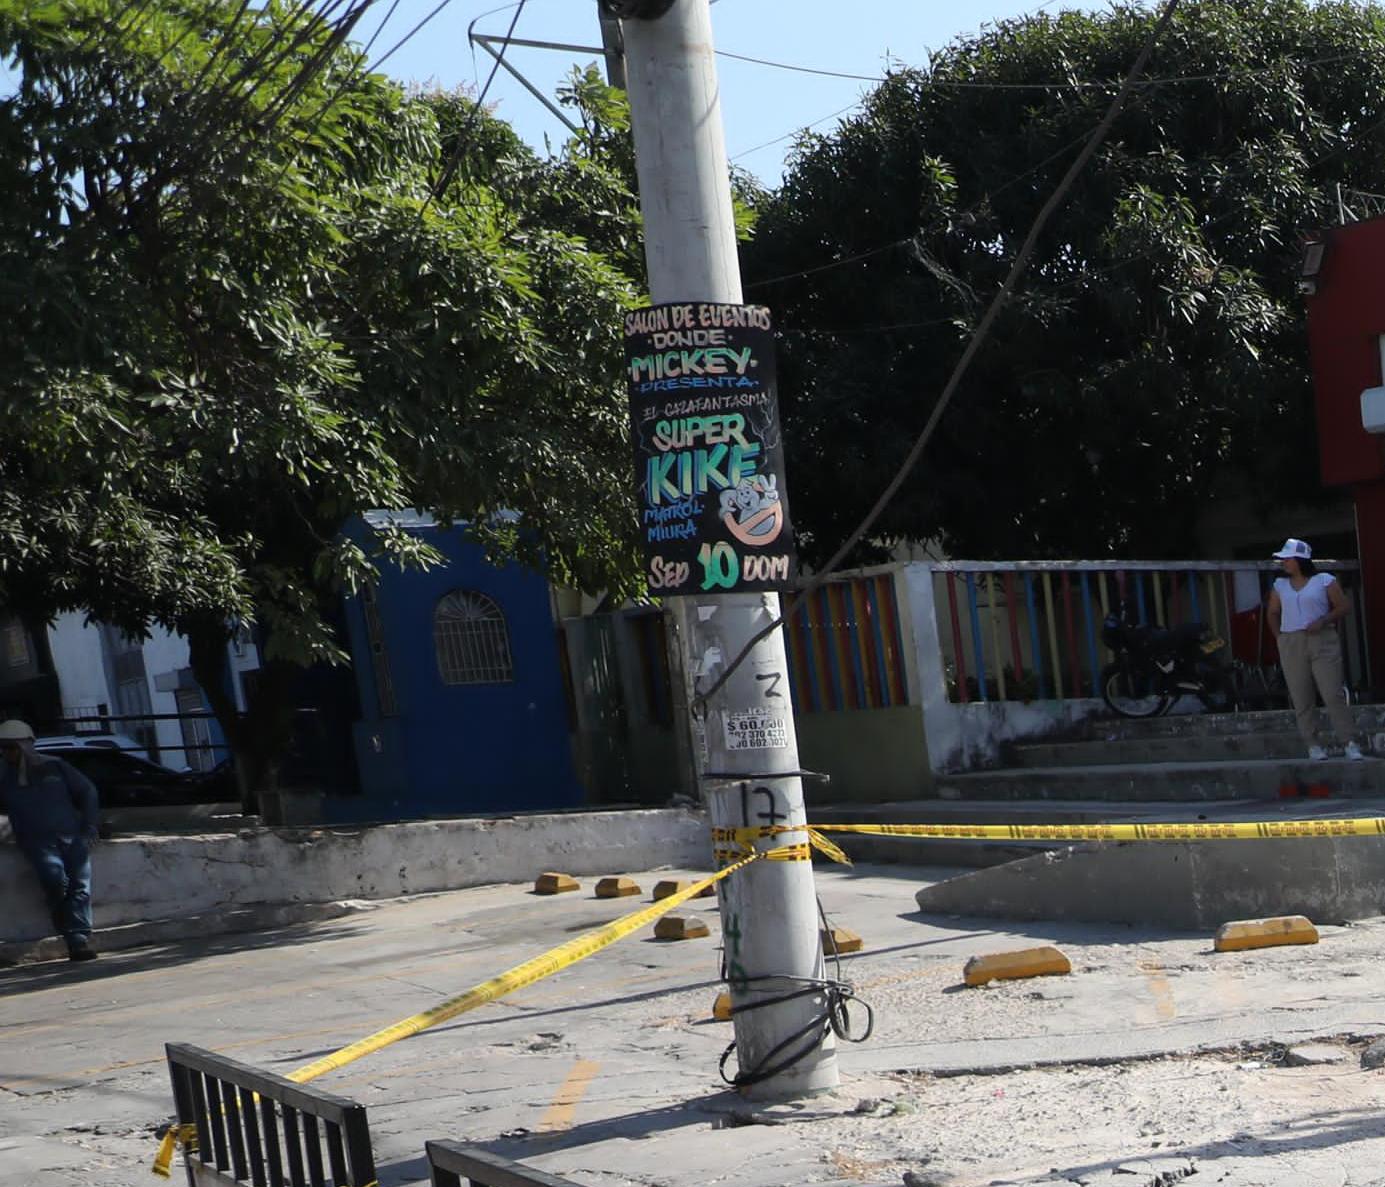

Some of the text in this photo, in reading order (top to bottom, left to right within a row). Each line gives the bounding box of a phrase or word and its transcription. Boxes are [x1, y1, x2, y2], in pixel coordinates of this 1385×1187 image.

[625, 304, 772, 336] SALON DE EVENTOS
[652, 413, 749, 450] SUPER
[649, 442, 762, 505] KIKE
[697, 541, 739, 590] 10
[743, 554, 789, 581] DOM
